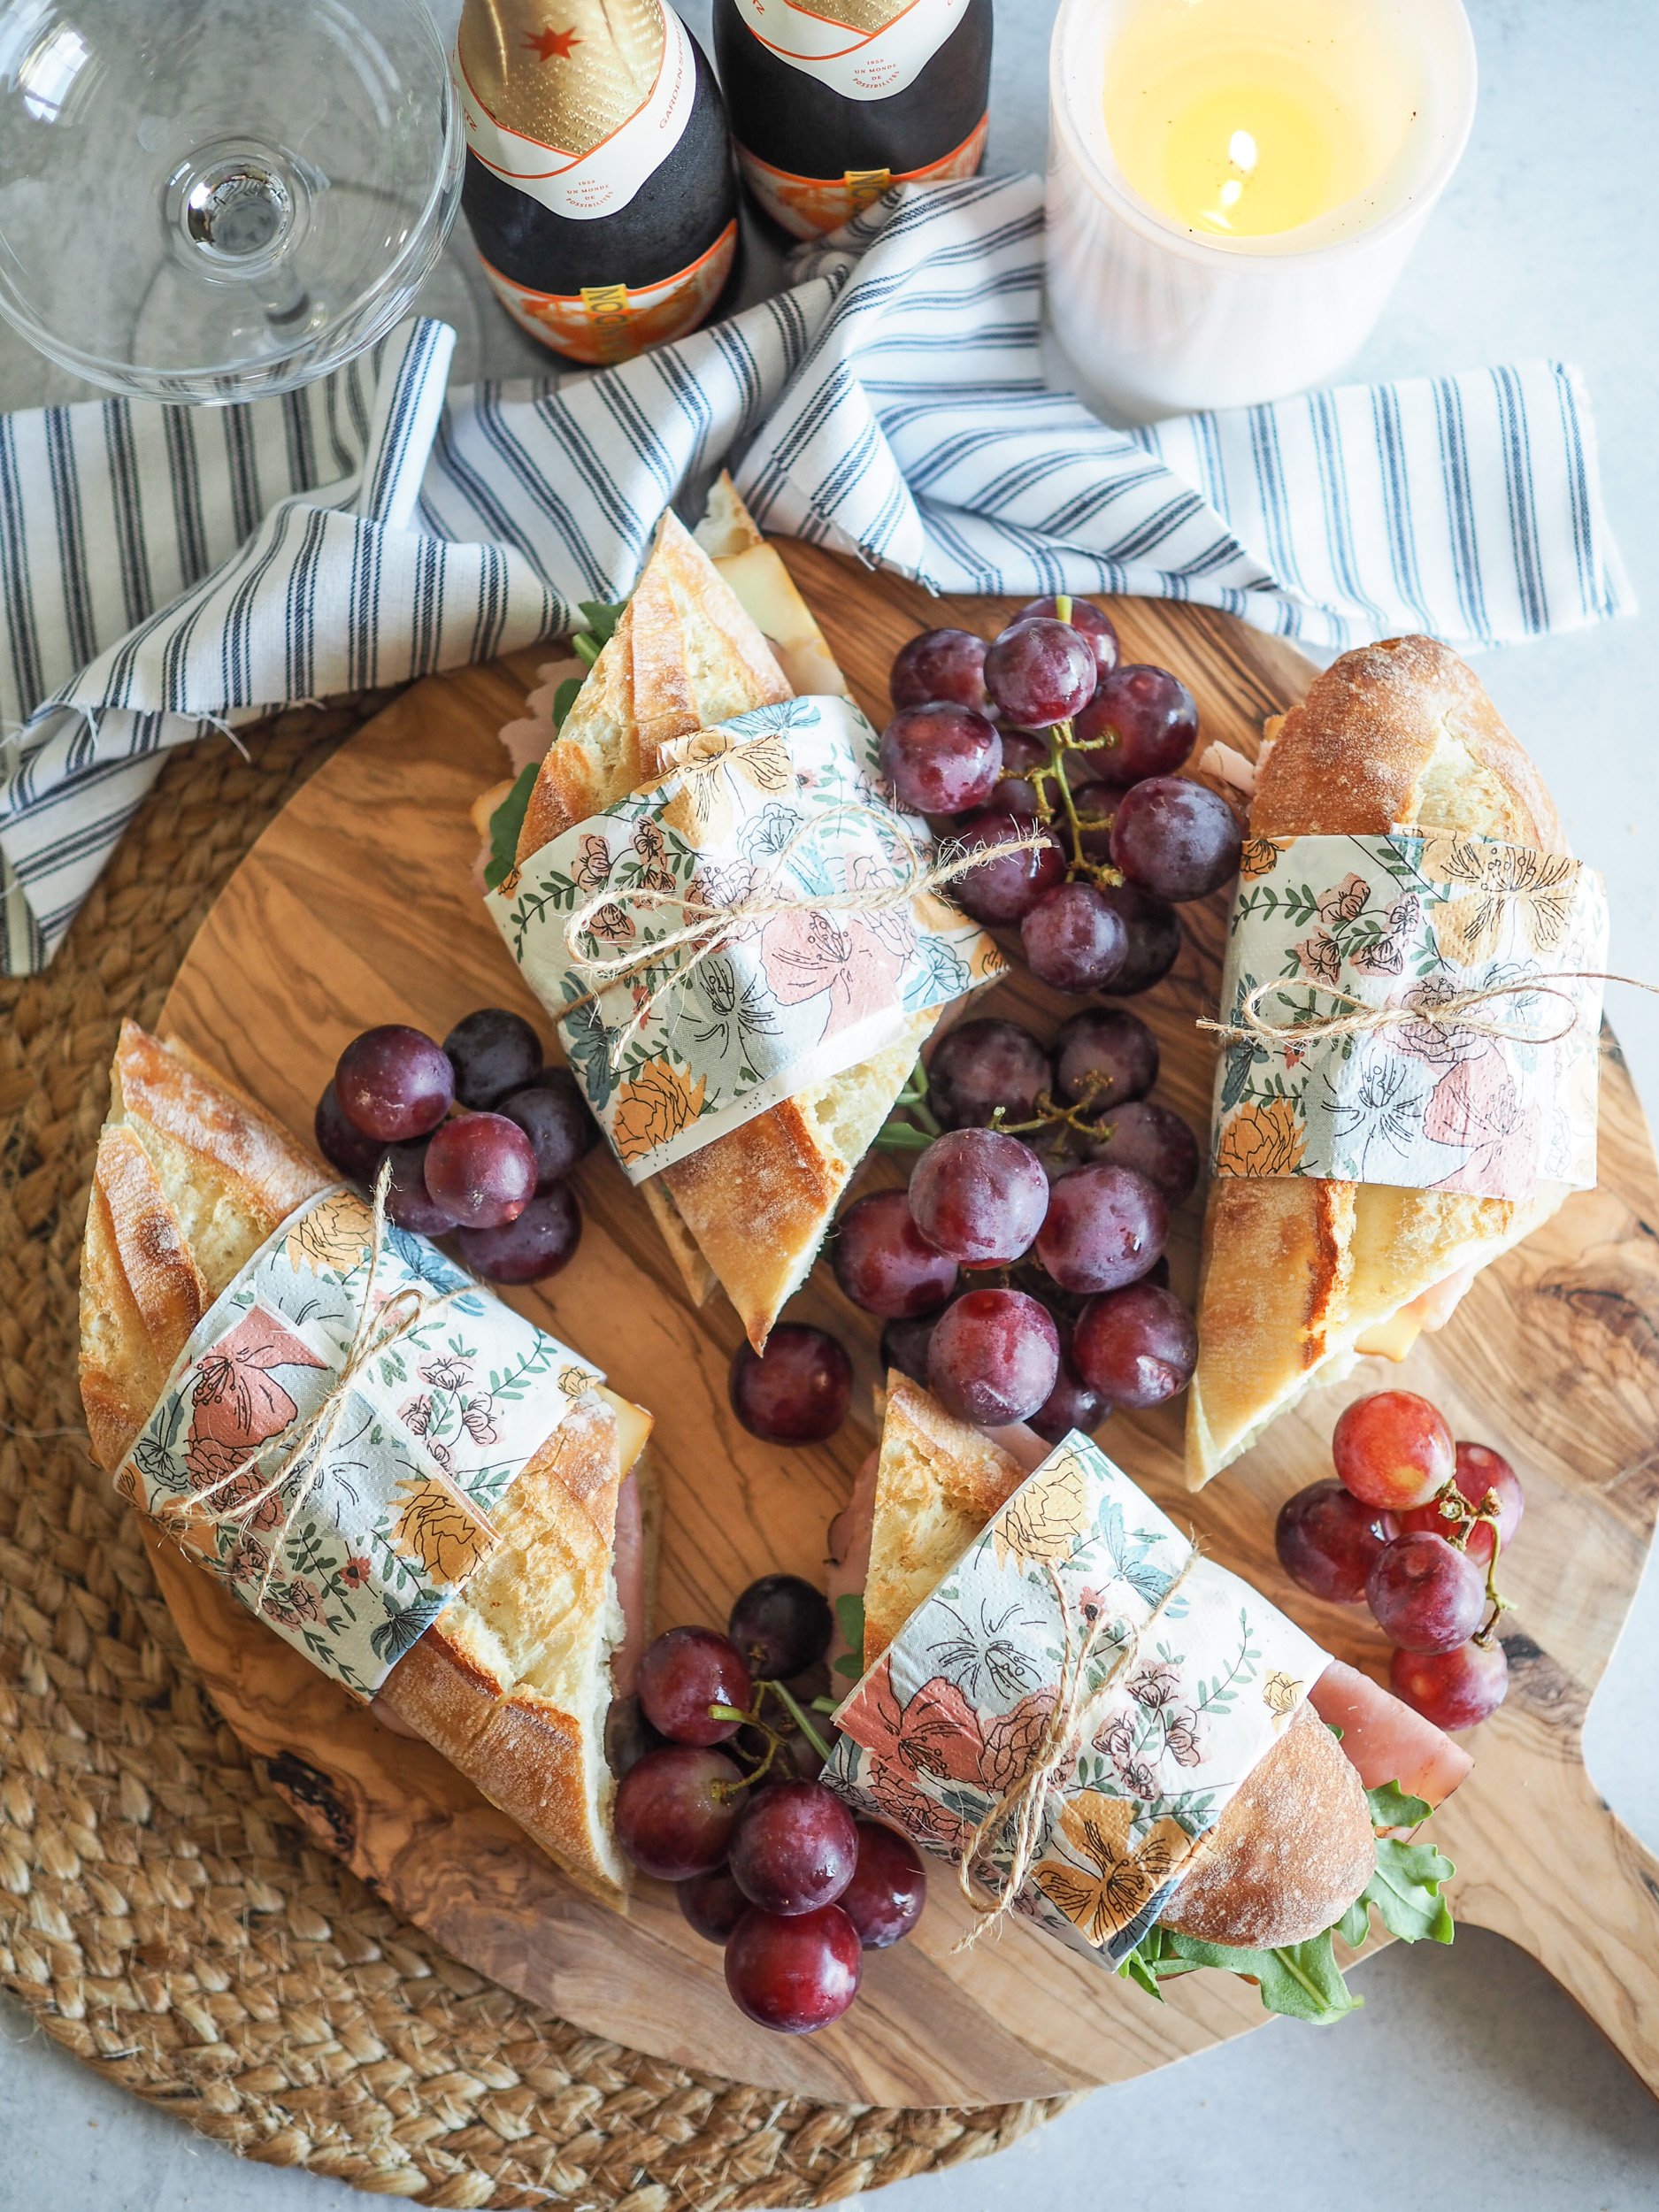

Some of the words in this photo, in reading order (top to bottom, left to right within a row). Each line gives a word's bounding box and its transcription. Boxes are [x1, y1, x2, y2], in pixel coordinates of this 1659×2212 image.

[869, 64, 896, 73] MONDE
[659, 68, 683, 129] GARDEN
[581, 184, 609, 193] MONDE
